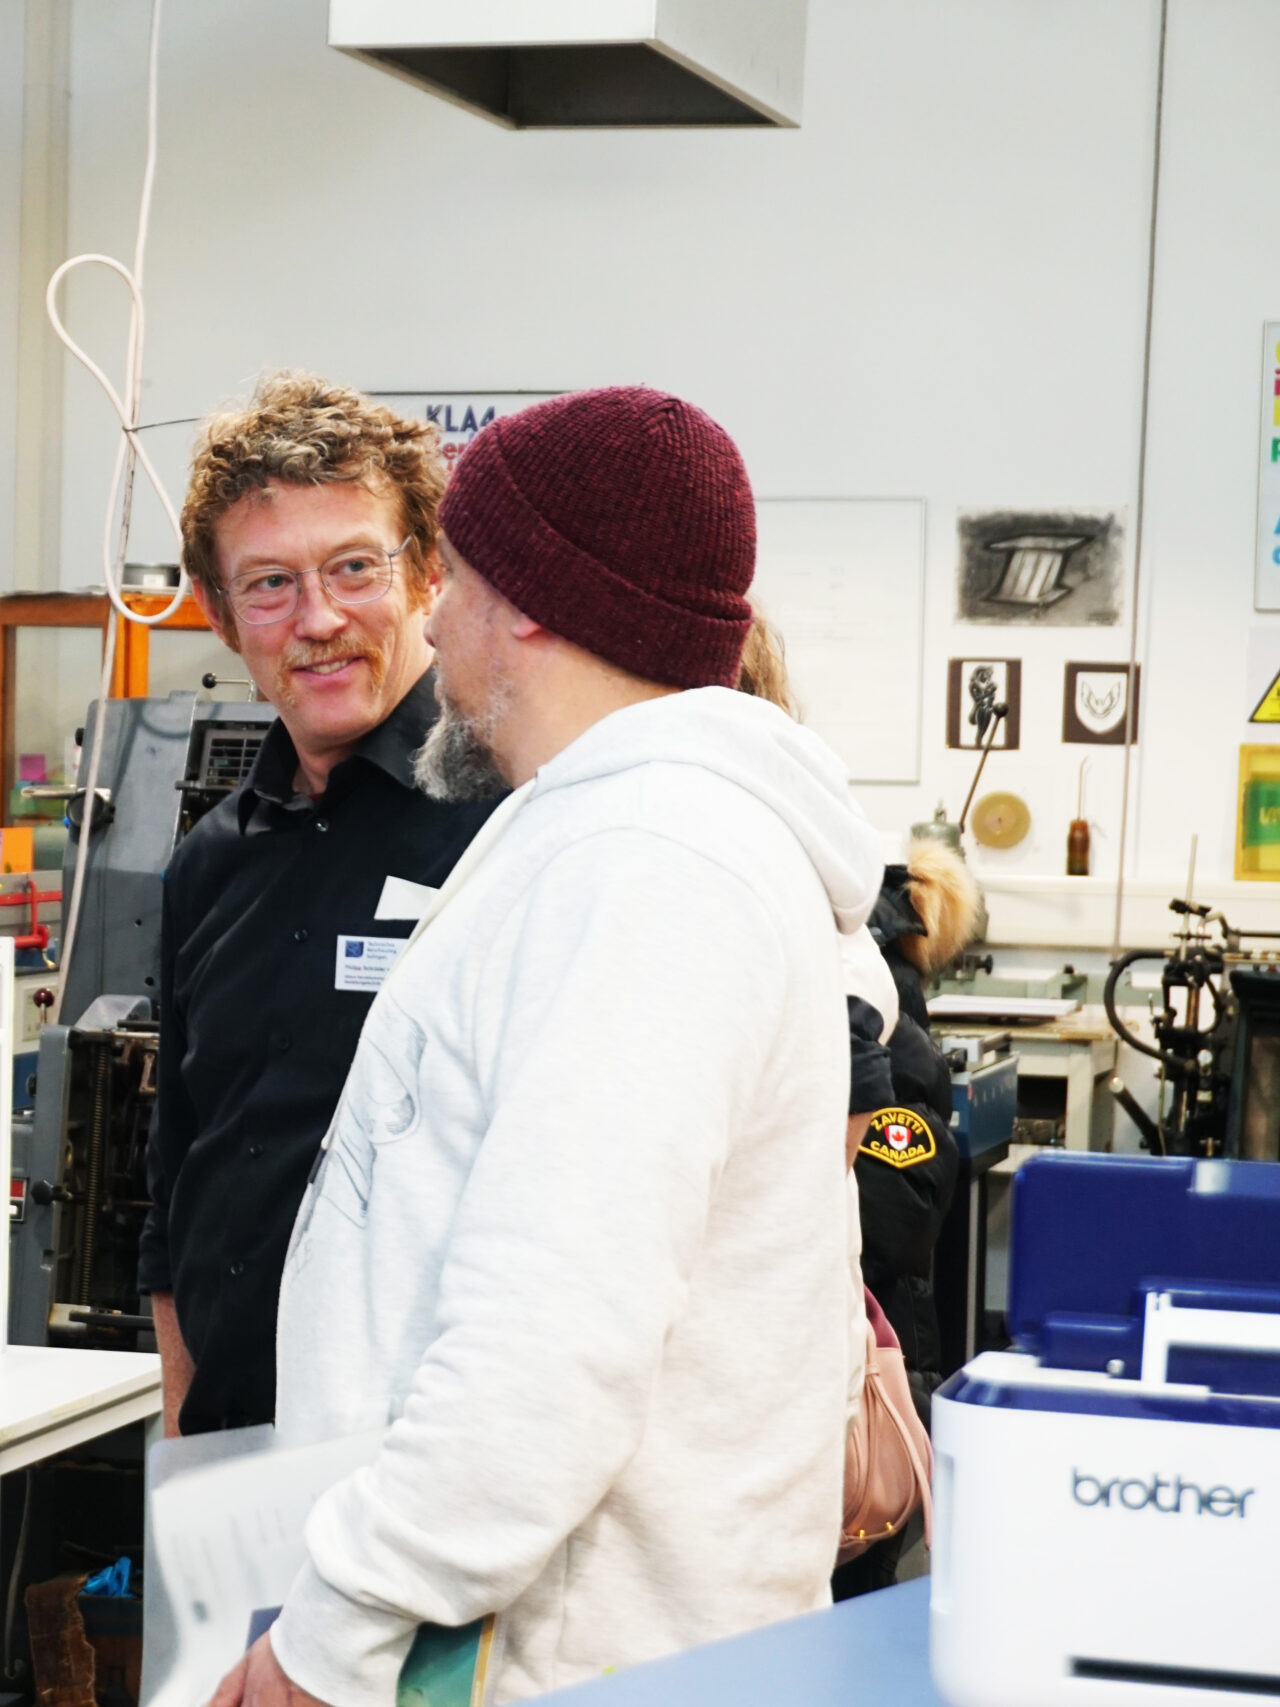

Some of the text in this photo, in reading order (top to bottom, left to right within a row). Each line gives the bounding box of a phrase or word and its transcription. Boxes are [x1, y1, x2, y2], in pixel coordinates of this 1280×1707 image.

[870, 1112, 924, 1135] ZAVETTI
[870, 1140, 926, 1161] CANADA
[1071, 1465, 1256, 1518] brother
